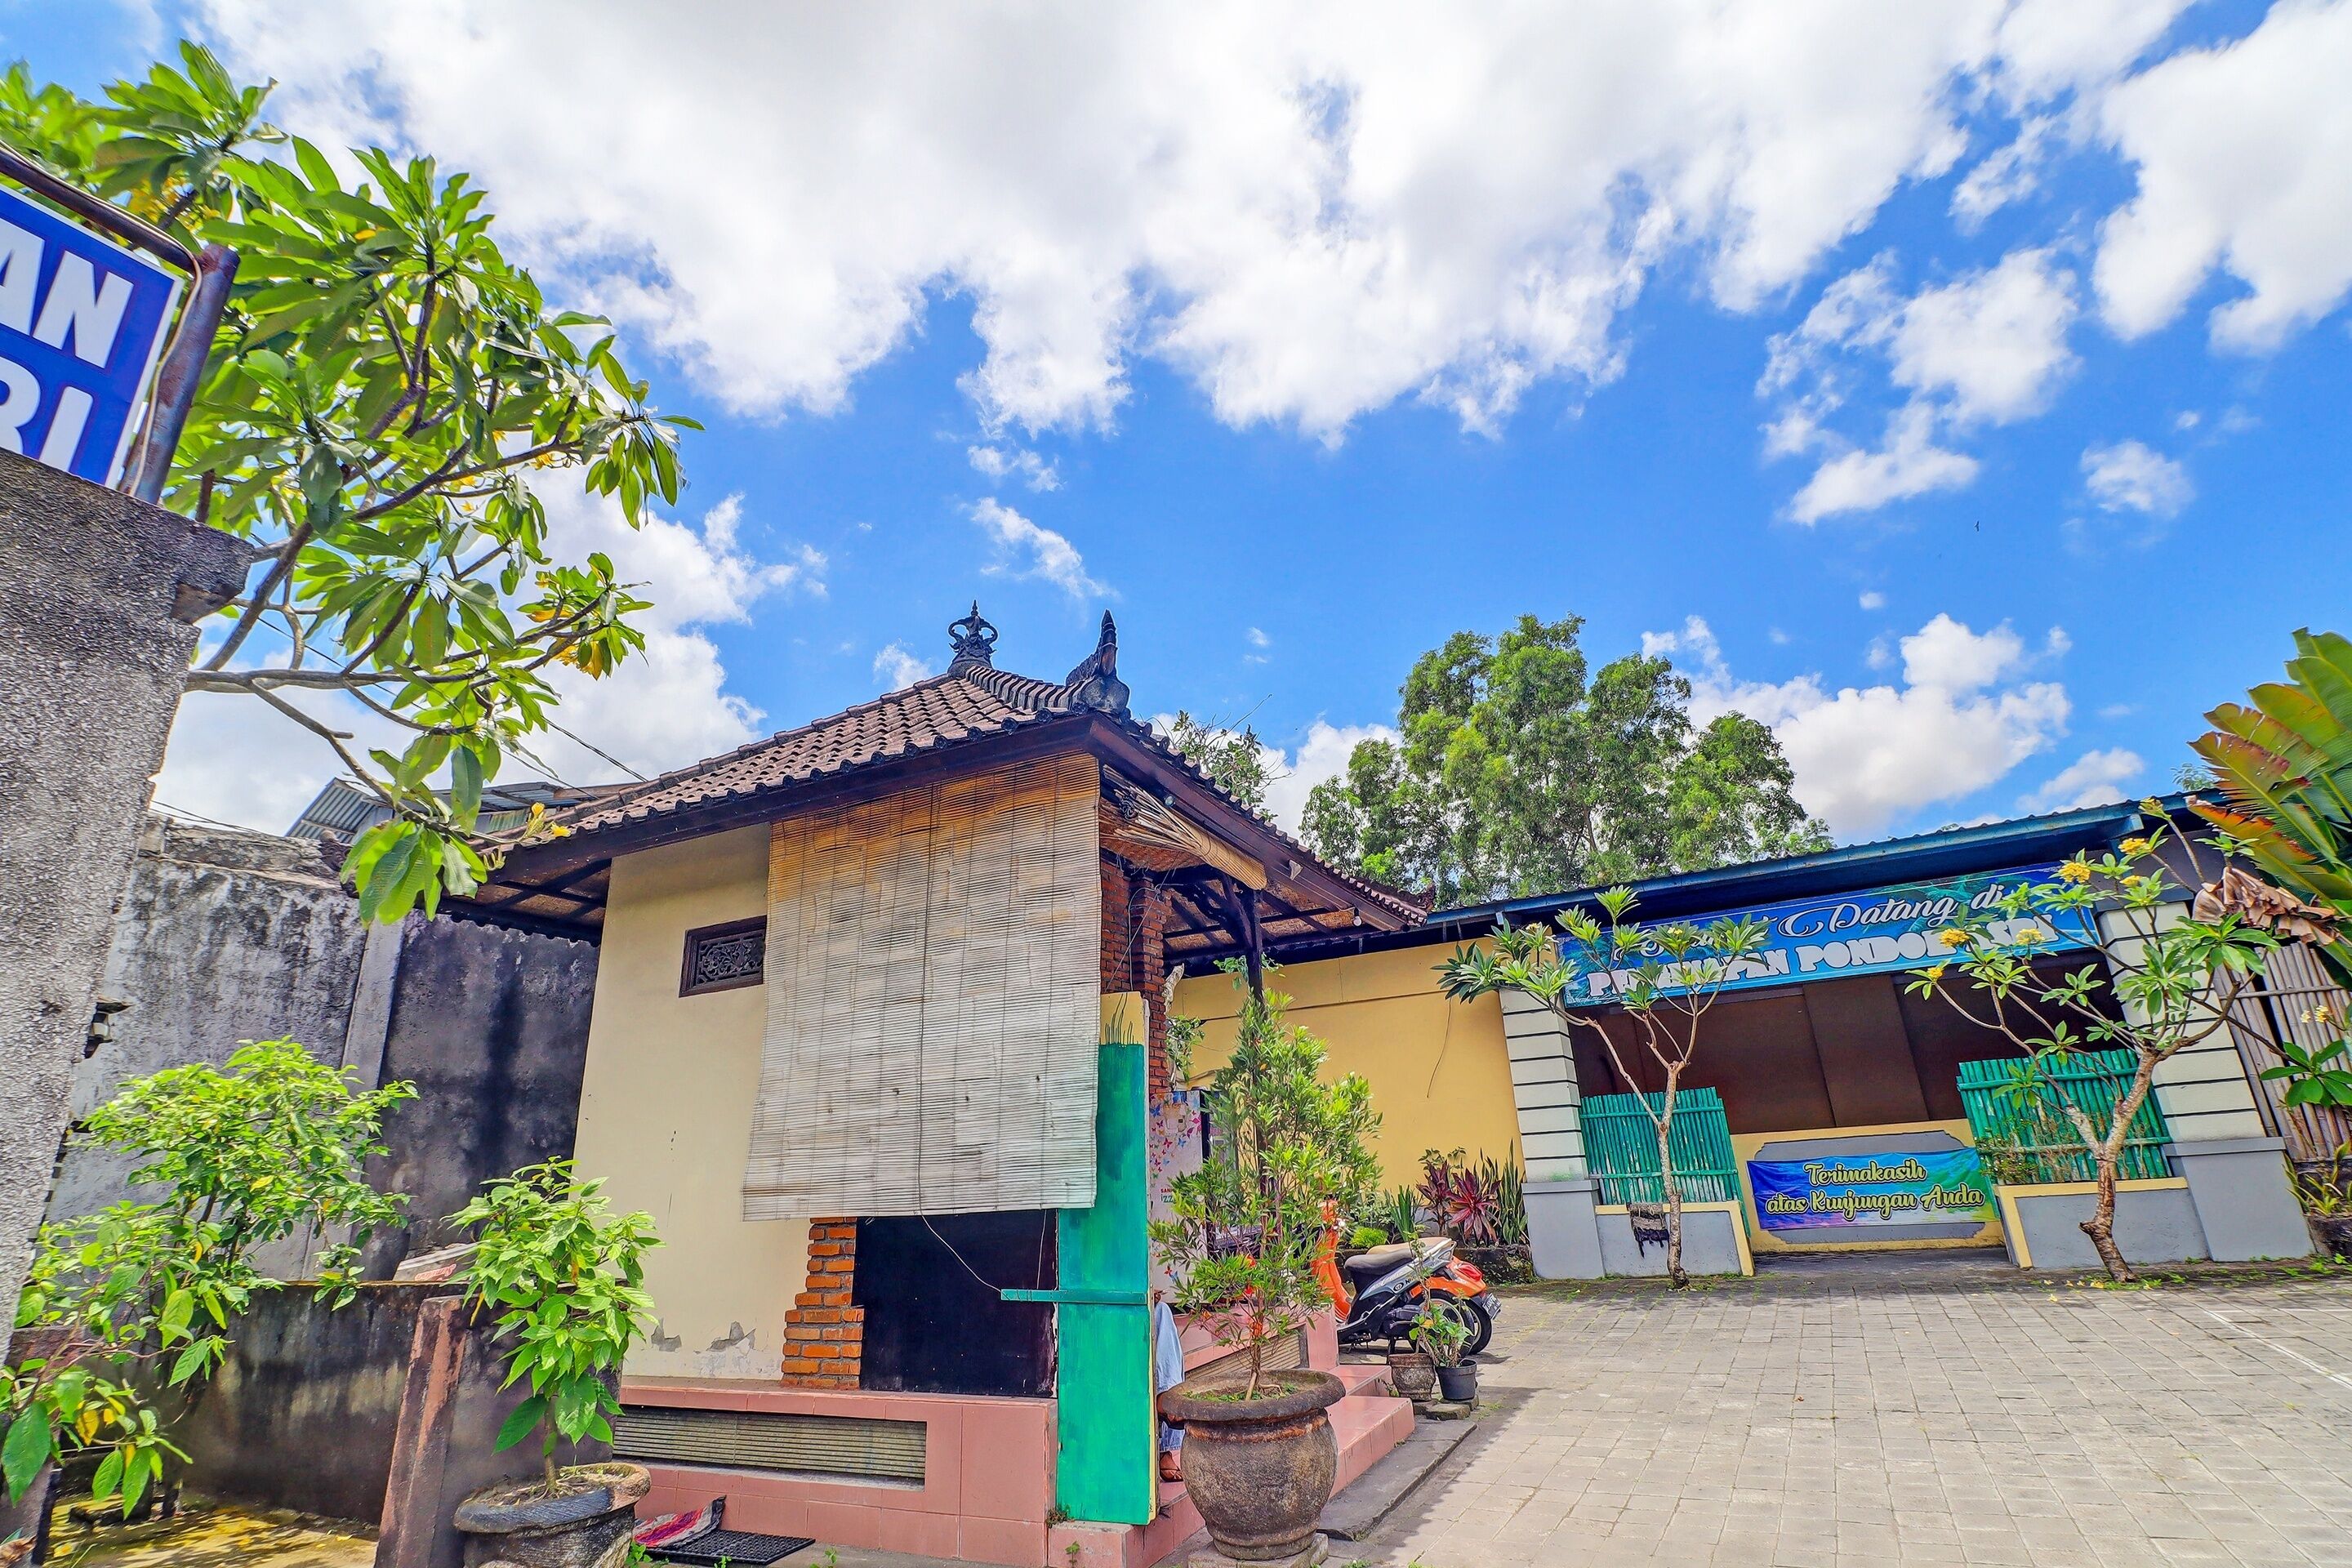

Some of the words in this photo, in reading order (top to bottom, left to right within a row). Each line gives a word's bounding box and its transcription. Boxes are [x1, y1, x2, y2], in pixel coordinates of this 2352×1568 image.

[1779, 897, 1959, 937] Datang
[1971, 884, 2005, 910] di
[1797, 929, 1958, 972] PONDOK
[1803, 1158, 1927, 1186] Terimakasih
[1766, 1193, 1809, 1214] atas
[1810, 1189, 1918, 1221] Kunjungan
[1919, 1183, 1984, 1210] Anda
